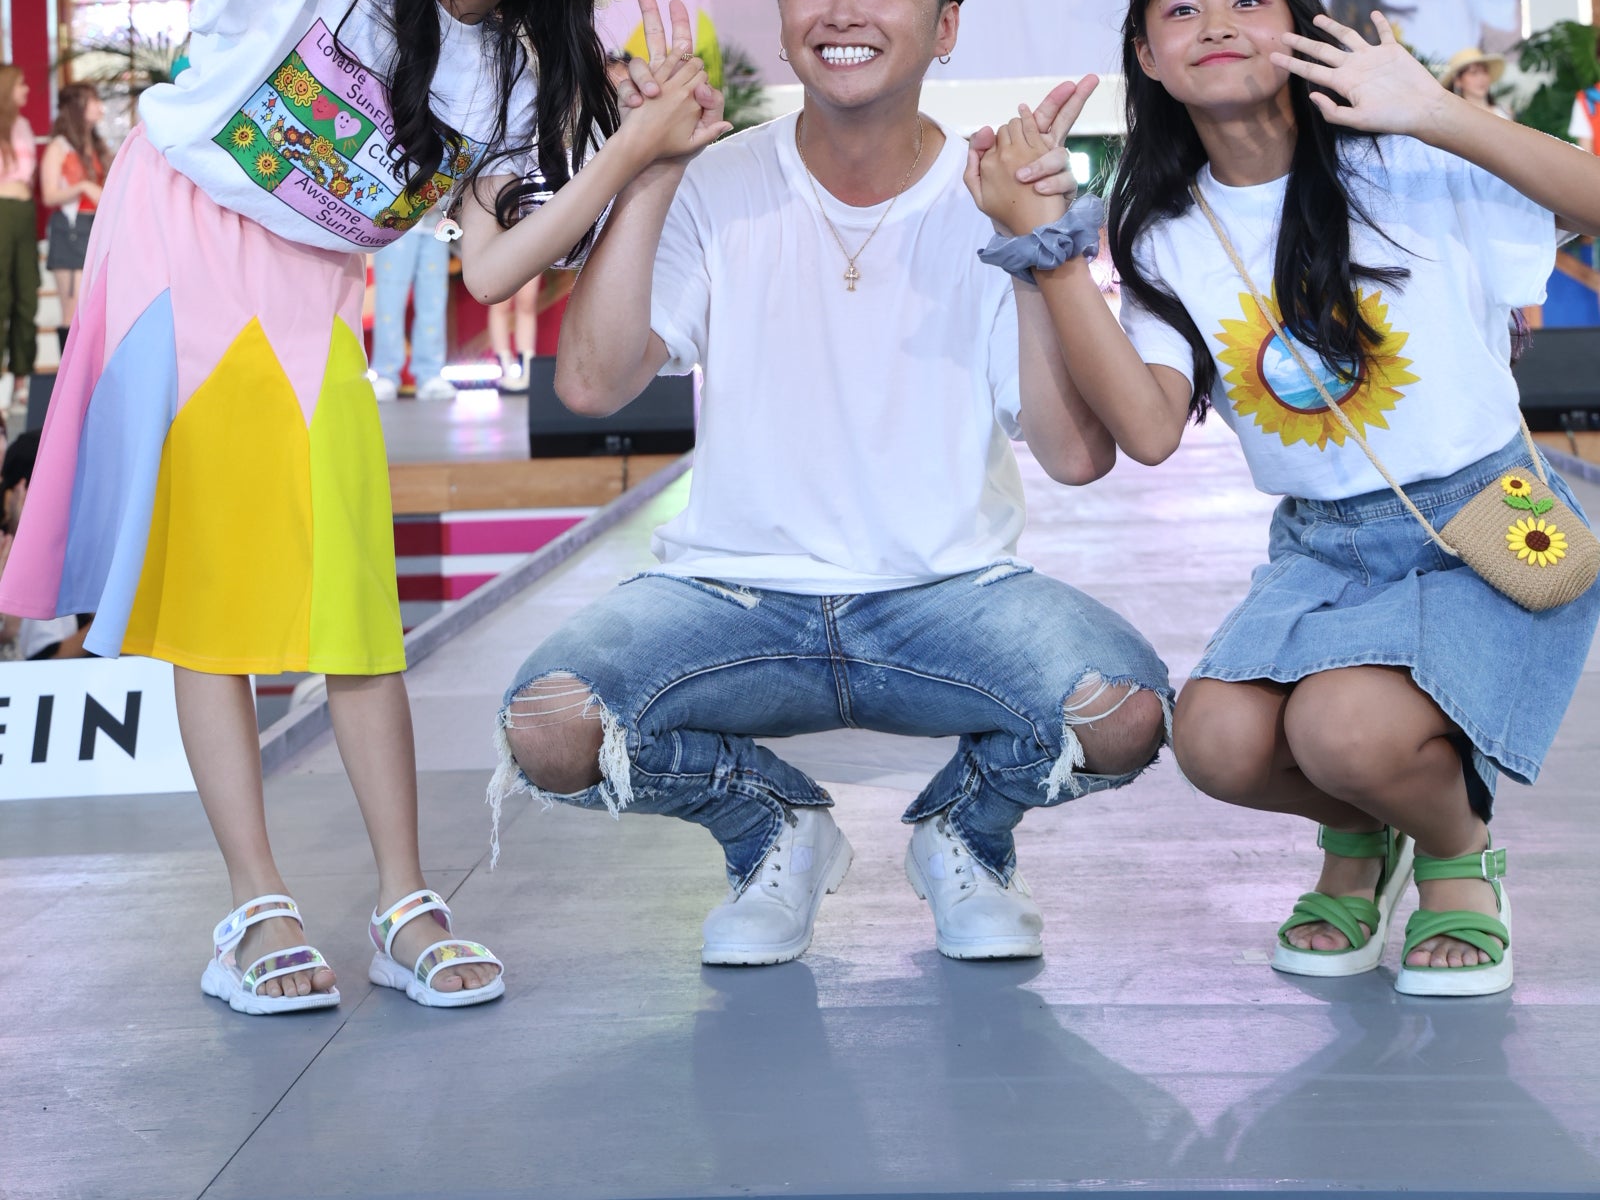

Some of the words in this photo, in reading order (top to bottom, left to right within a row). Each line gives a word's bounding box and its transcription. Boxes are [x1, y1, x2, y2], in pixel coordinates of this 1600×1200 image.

[316, 32, 366, 86] Lovable
[368, 143, 404, 180] Cute
[294, 176, 361, 226] Awsome
[0, 690, 143, 764] IN
